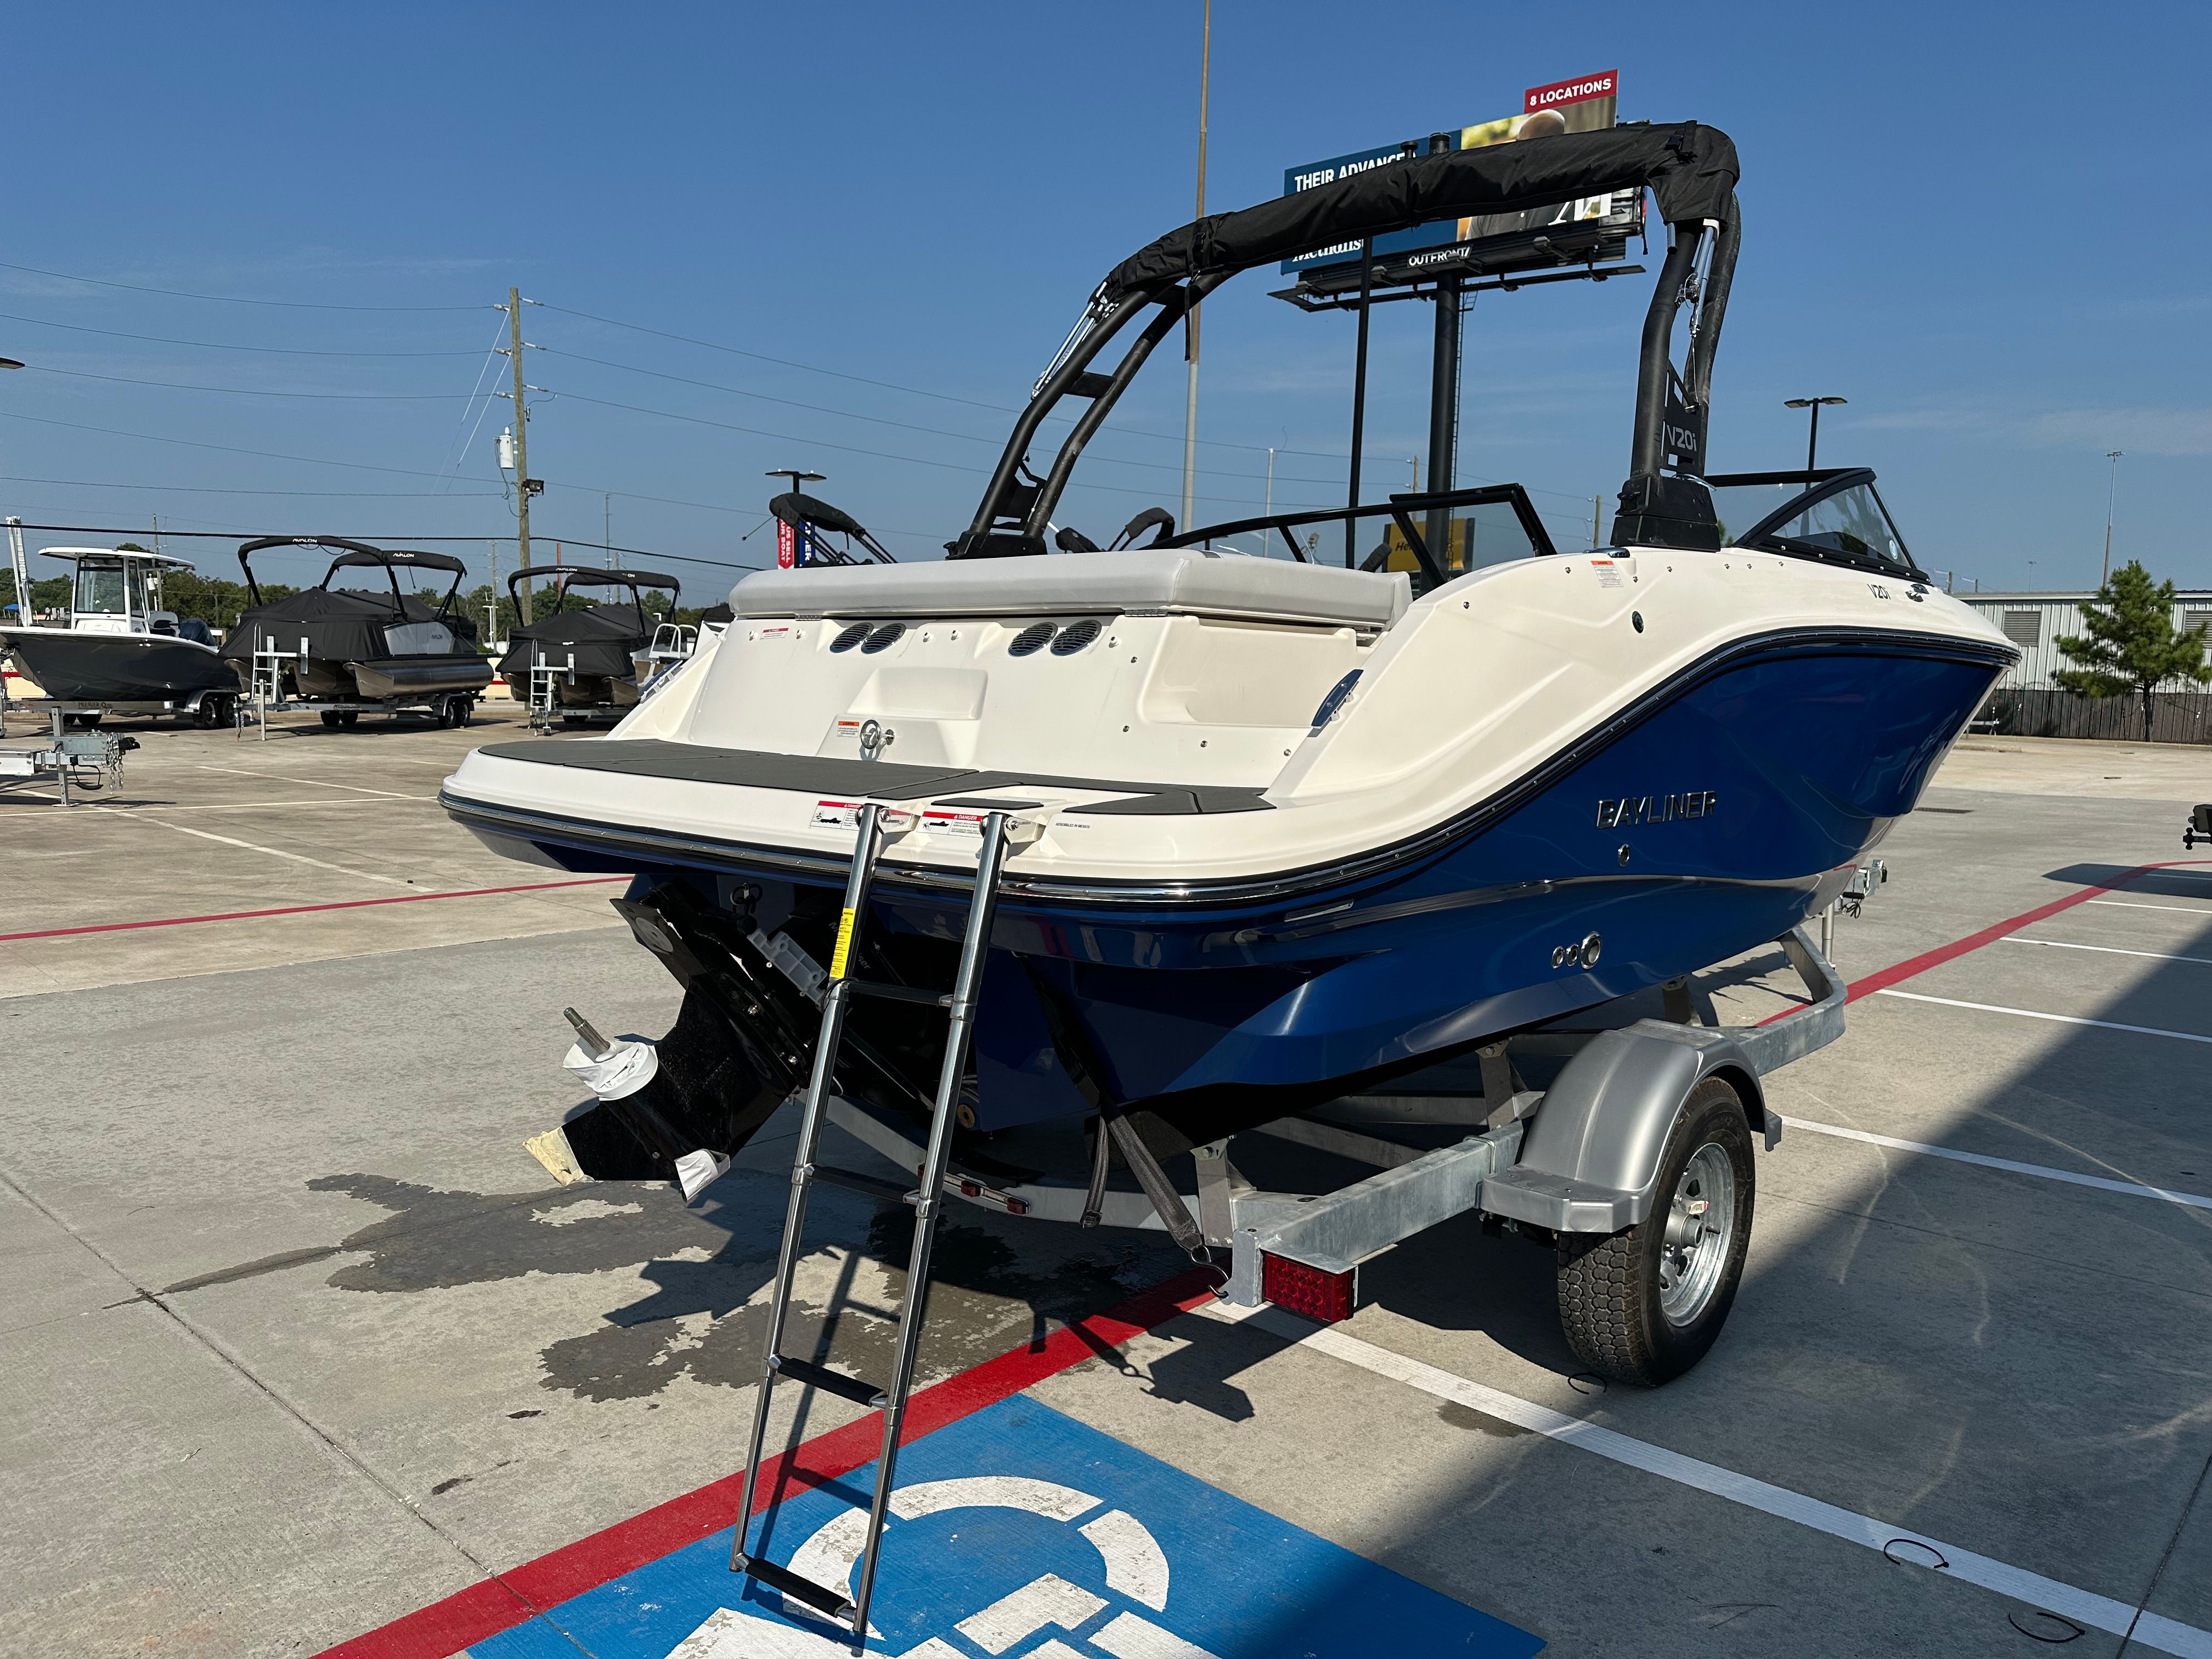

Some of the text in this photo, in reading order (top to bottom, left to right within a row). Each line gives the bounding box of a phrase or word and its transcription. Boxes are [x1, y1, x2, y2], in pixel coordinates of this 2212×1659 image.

[1530, 78, 1611, 106] 8 LOCATIONS
[1294, 168, 1334, 192] THEIR
[1666, 425, 1697, 452] V20i
[1866, 583, 1891, 600] V20i
[1595, 790, 1717, 830] BAYLINER
